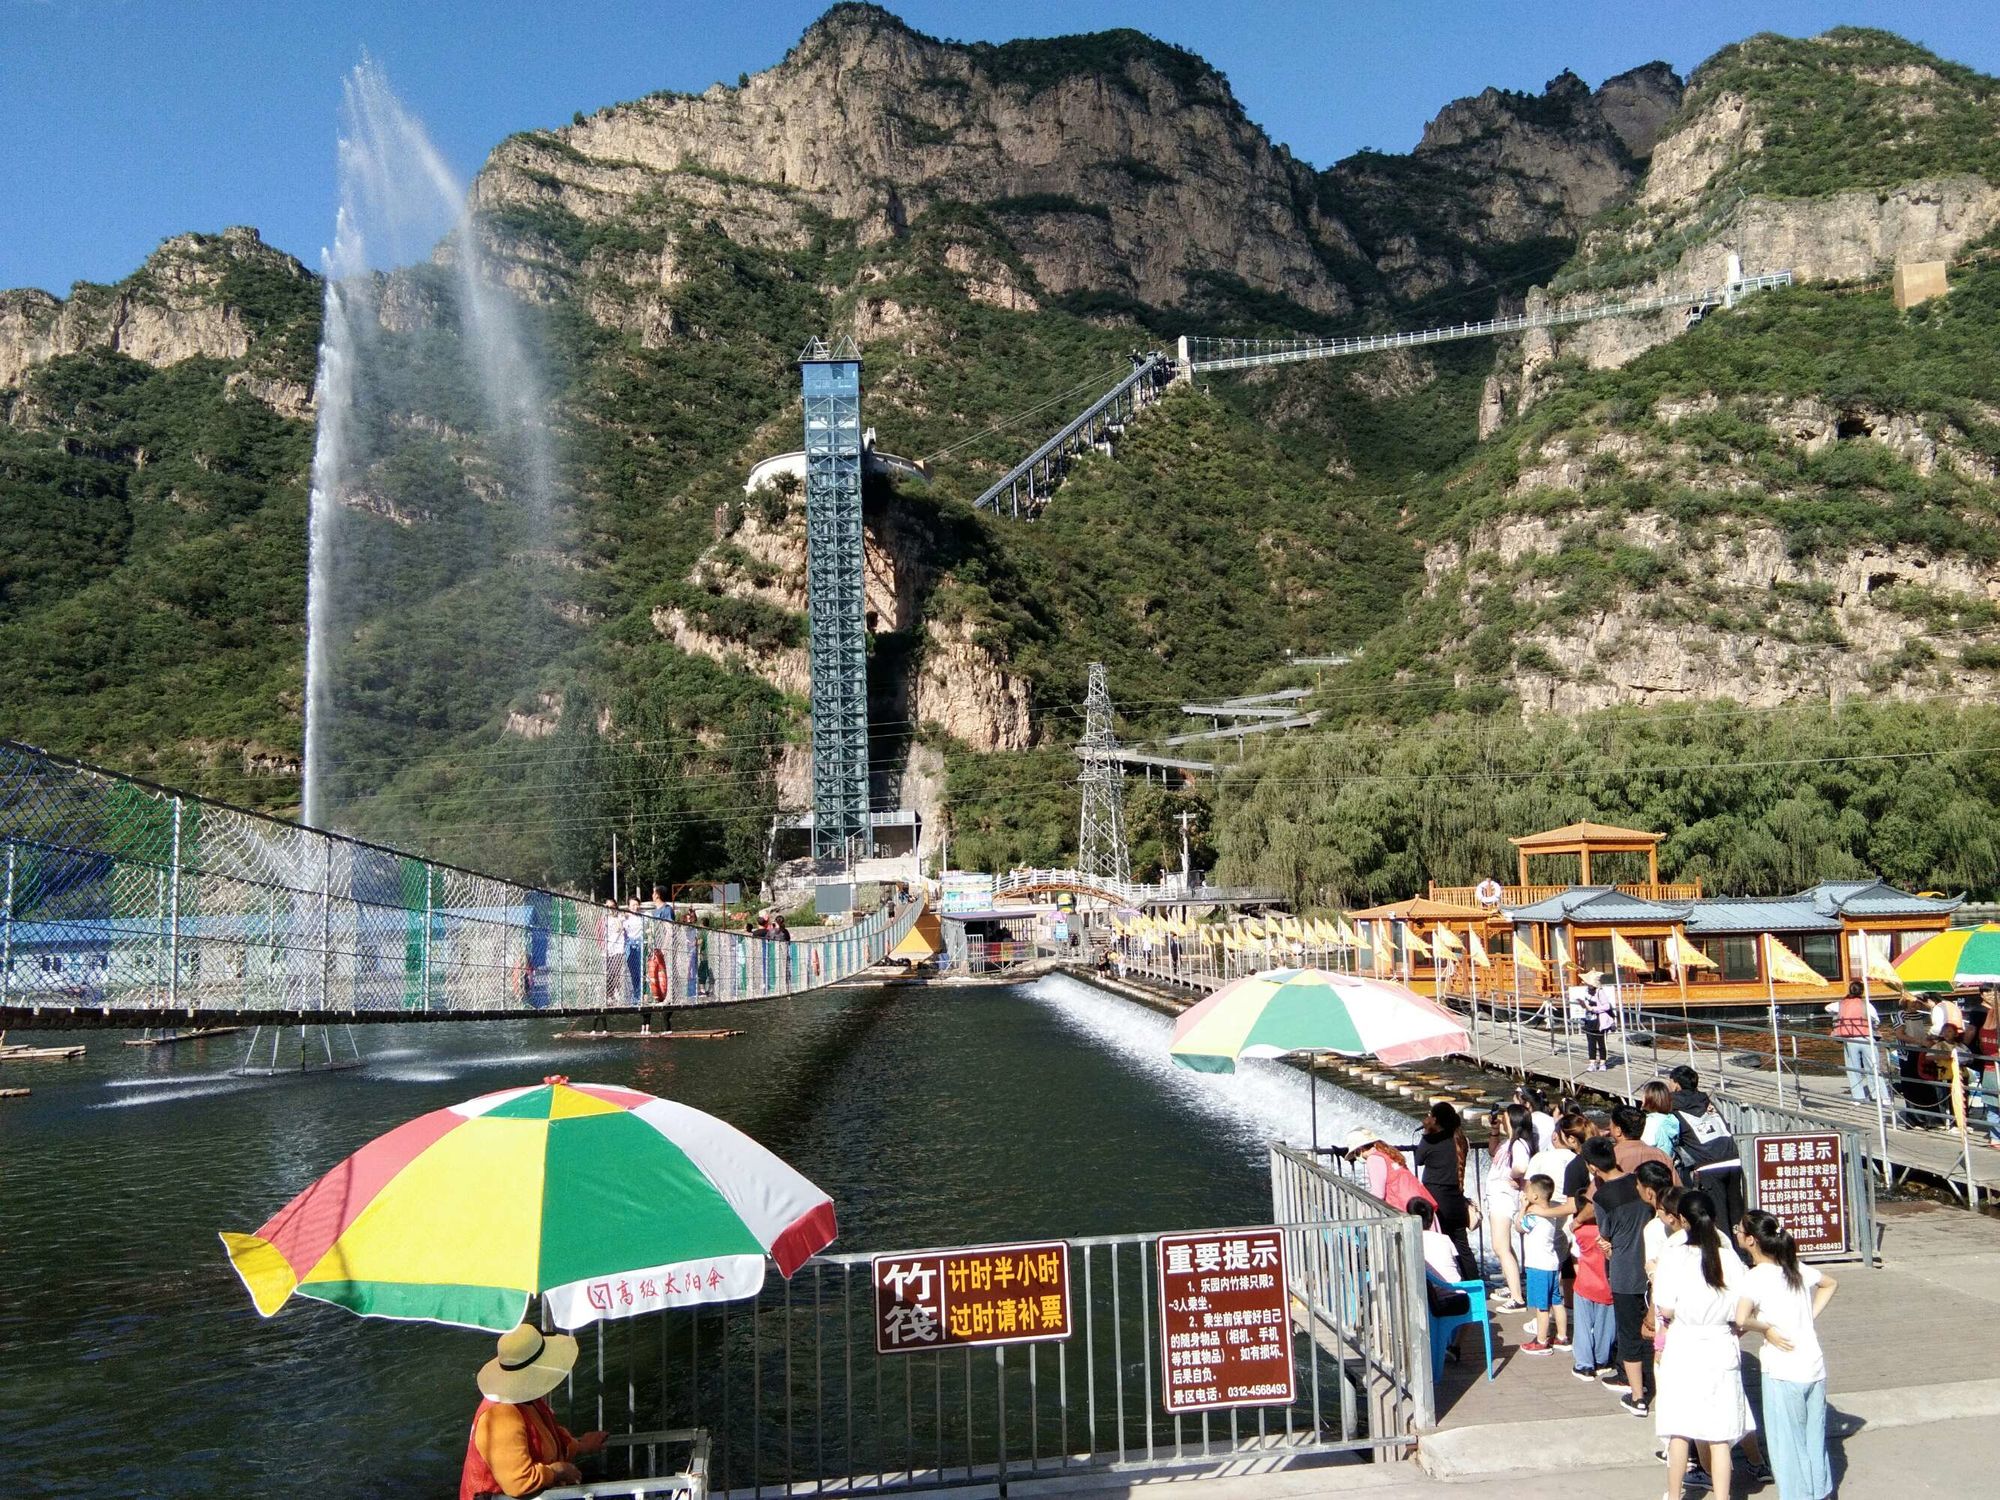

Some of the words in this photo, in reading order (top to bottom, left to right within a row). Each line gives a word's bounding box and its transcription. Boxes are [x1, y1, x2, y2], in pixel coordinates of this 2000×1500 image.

[1764, 1142, 1832, 1162] 温馨提示
[1166, 1239, 1279, 1275] 重要提示
[1799, 1243, 1841, 1252] 0312-4568493
[616, 1266, 725, 1306] 高级太阳伞
[948, 1251, 1060, 1293] 计时半小时
[883, 1262, 938, 1344] 竹筏
[950, 1294, 1063, 1336] 过时请补票
